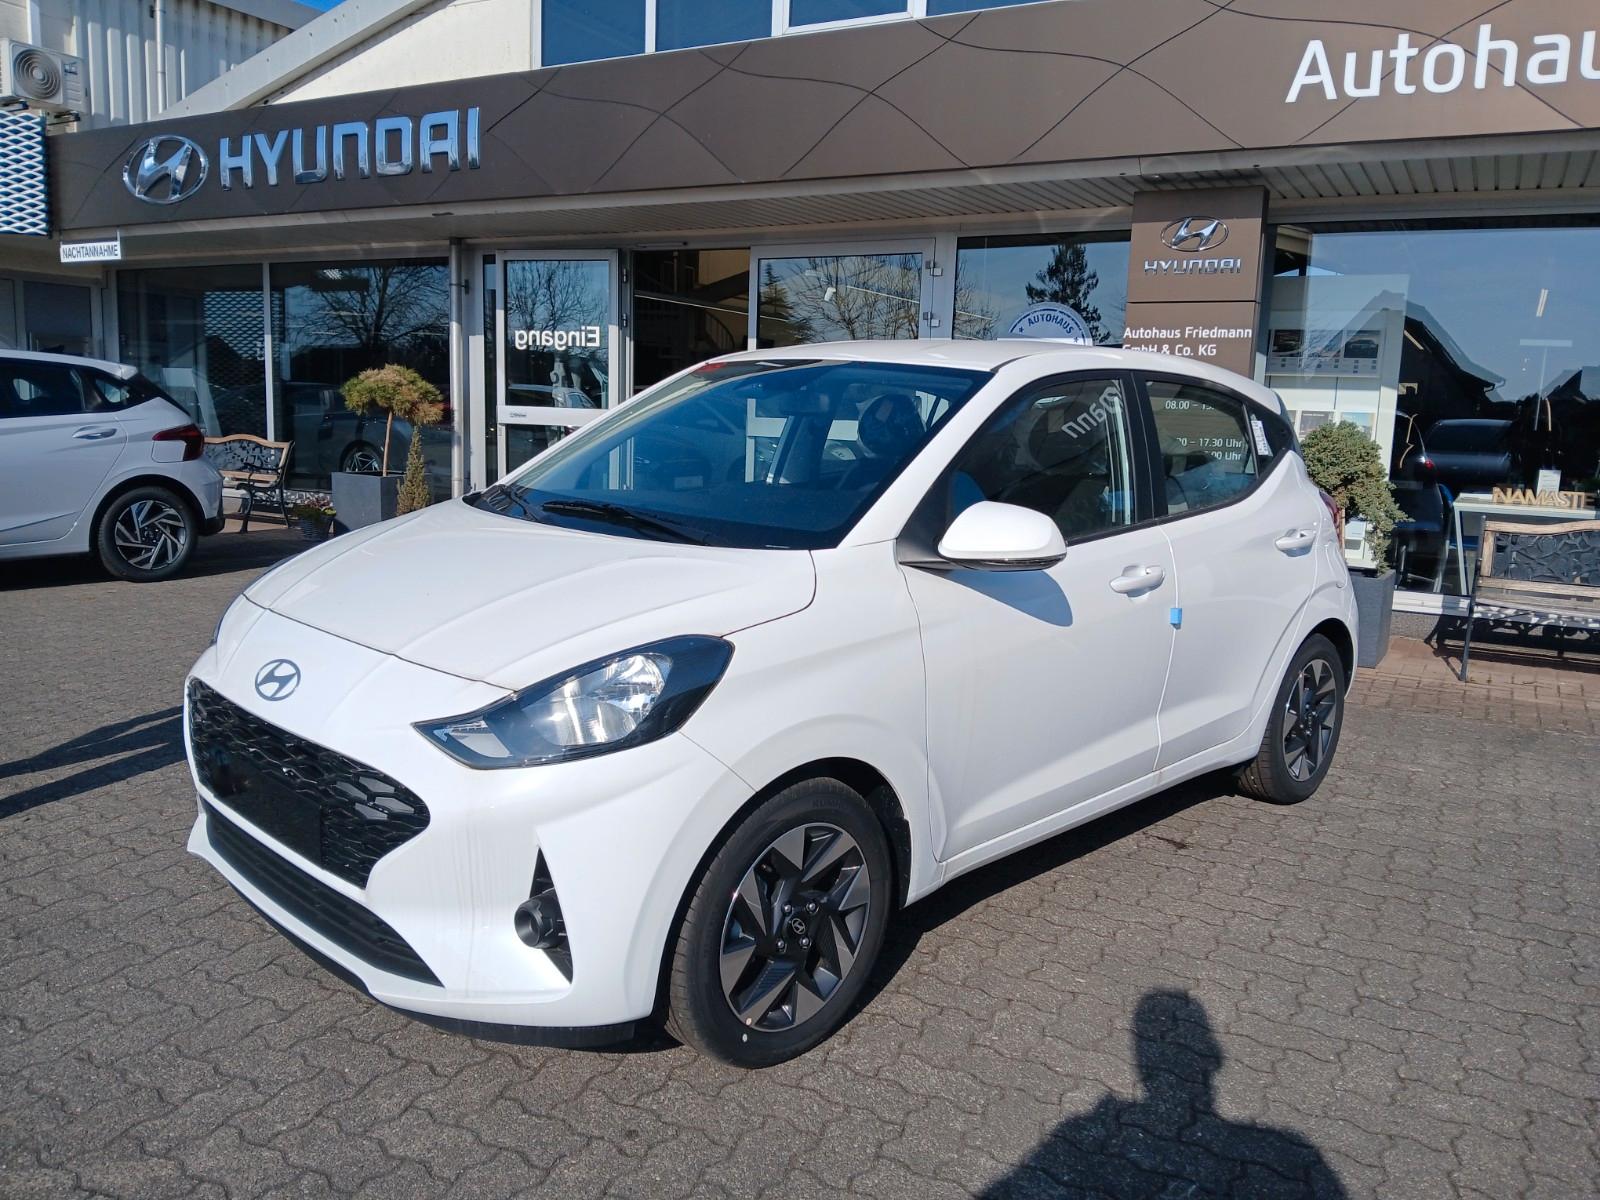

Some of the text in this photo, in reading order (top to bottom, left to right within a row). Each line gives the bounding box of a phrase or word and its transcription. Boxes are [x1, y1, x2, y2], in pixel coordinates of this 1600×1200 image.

[219, 107, 481, 191] HYUNDAI
[62, 244, 118, 259] NACHTANNAHME
[1143, 258, 1242, 275] HYUNDAI
[1027, 313, 1074, 334] AUTOHAUS
[1123, 326, 1252, 339] Autohaus Friedmann
[1161, 344, 1170, 355] &
[1175, 345, 1194, 356] Co.
[1198, 344, 1217, 356] KG
[1165, 401, 1190, 410] 08.00
[1199, 438, 1223, 448] 17.30
[1225, 438, 1243, 448] Uhr
[1225, 451, 1242, 460] Uhr
[1492, 487, 1597, 509] NAMASTE
